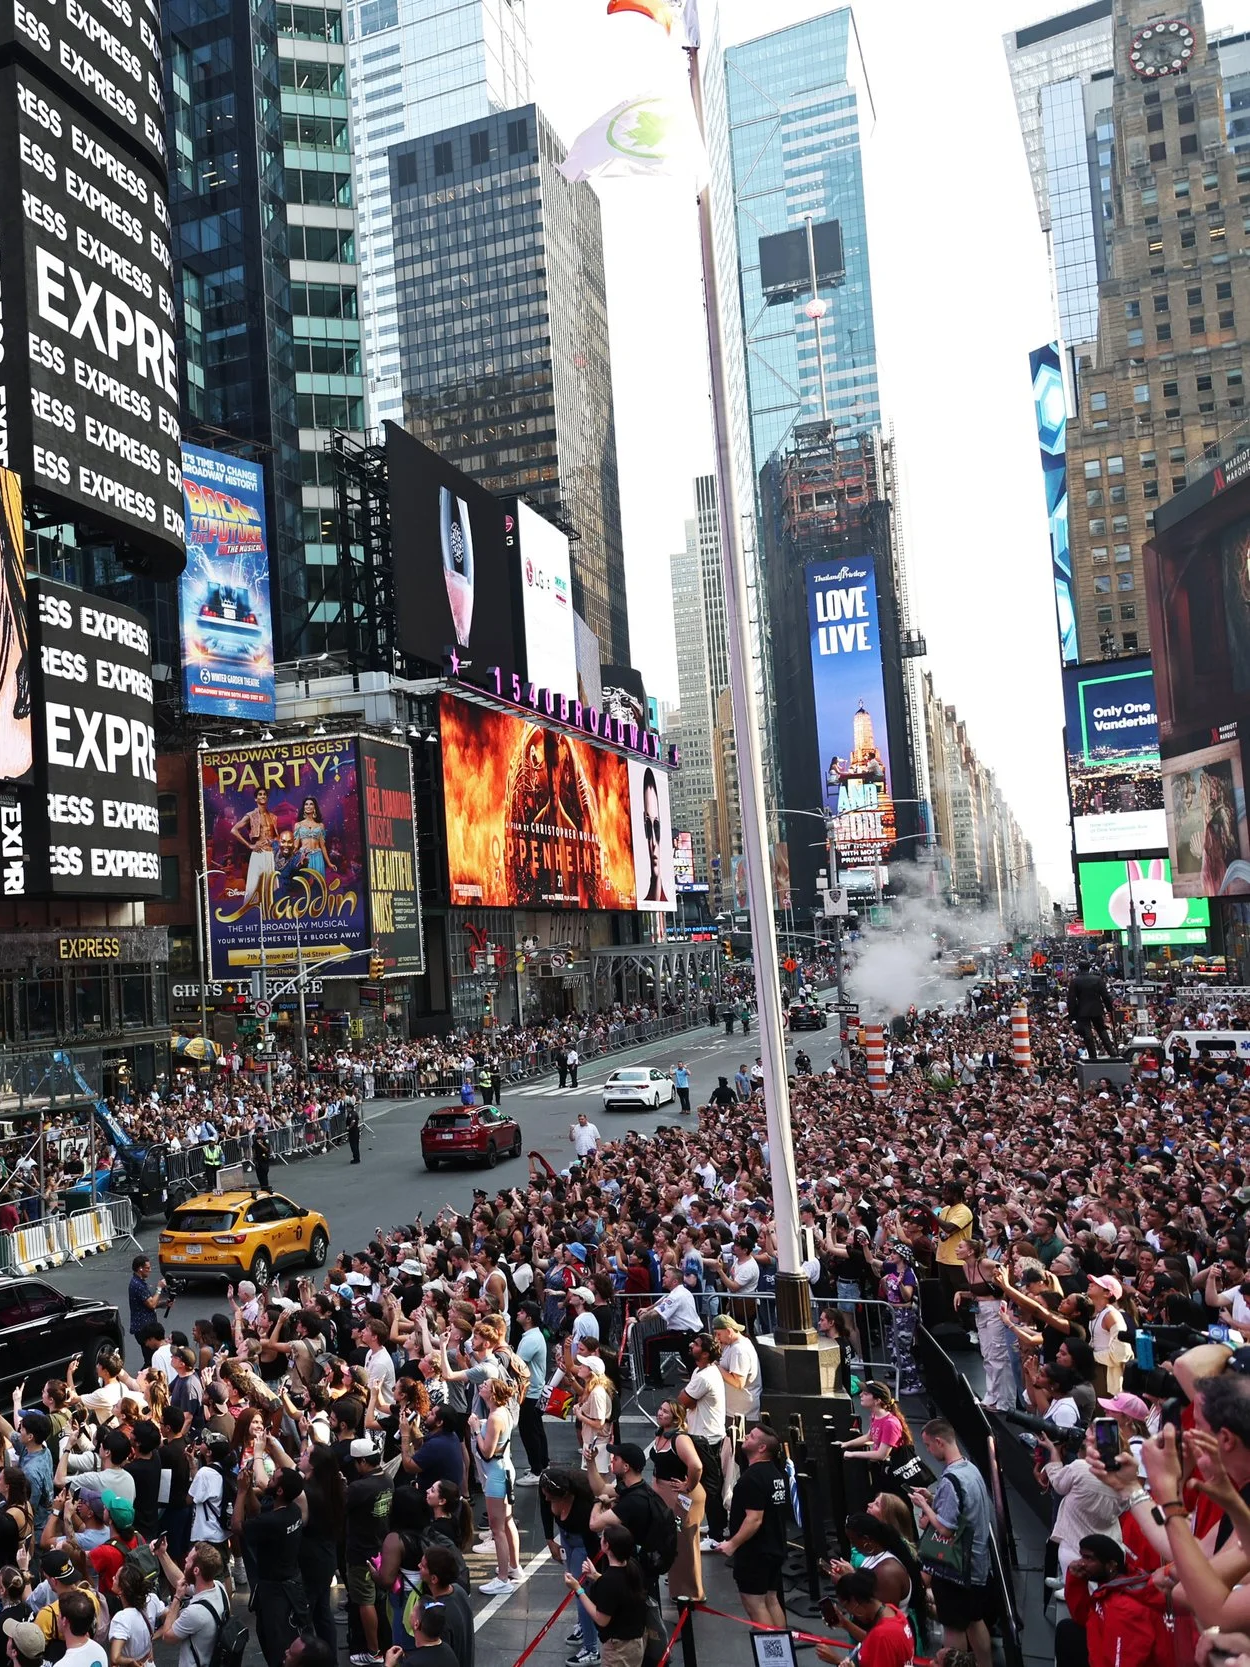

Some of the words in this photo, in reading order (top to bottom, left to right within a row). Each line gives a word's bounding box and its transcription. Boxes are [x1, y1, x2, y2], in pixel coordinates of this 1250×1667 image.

[66, 0, 142, 82] EXPRESS
[60, 39, 137, 125] EXPRESS
[71, 125, 148, 204] EXPRESS
[65, 167, 143, 244] EXPRESS
[76, 226, 151, 299] EXPRESS
[74, 358, 151, 422] EXPRESS
[85, 415, 161, 475] EXPRESS
[182, 463, 224, 482] BROADWAY
[225, 475, 258, 492] HISTORY!
[196, 456, 214, 469] TIME
[215, 461, 225, 472] TO
[227, 466, 257, 482] CHANGE
[79, 466, 156, 523] EXPRESS
[208, 518, 262, 543] FUTURE
[227, 545, 238, 553] THE
[239, 544, 261, 552] MUSICAL
[815, 586, 869, 622] LOVE
[80, 606, 149, 656] EXPRESS
[818, 622, 871, 655] LIVE
[96, 659, 153, 705] EXPRESS
[493, 666, 554, 715] 1540
[560, 696, 662, 761] BROADWAY
[1093, 705, 1122, 720] Only
[1124, 702, 1151, 714] One
[203, 747, 289, 767] BROADWAY'S
[292, 739, 351, 757] BIGGEST
[217, 754, 342, 794] PARTY!
[838, 778, 879, 813] AND
[102, 799, 160, 835] EXPRESS
[531, 822, 576, 840] CHRISTOPHER
[90, 848, 160, 881] EXPRESS
[370, 848, 376, 890] A
[376, 849, 414, 891] BEAUTIFUL
[214, 867, 358, 924] Aladdin
[371, 891, 395, 933] NOISE
[227, 925, 243, 933] THE
[262, 922, 308, 931] BROADWAY
[311, 920, 348, 929] MUSICAL
[258, 935, 281, 943] COMES
[59, 937, 120, 959] EXPRESS
